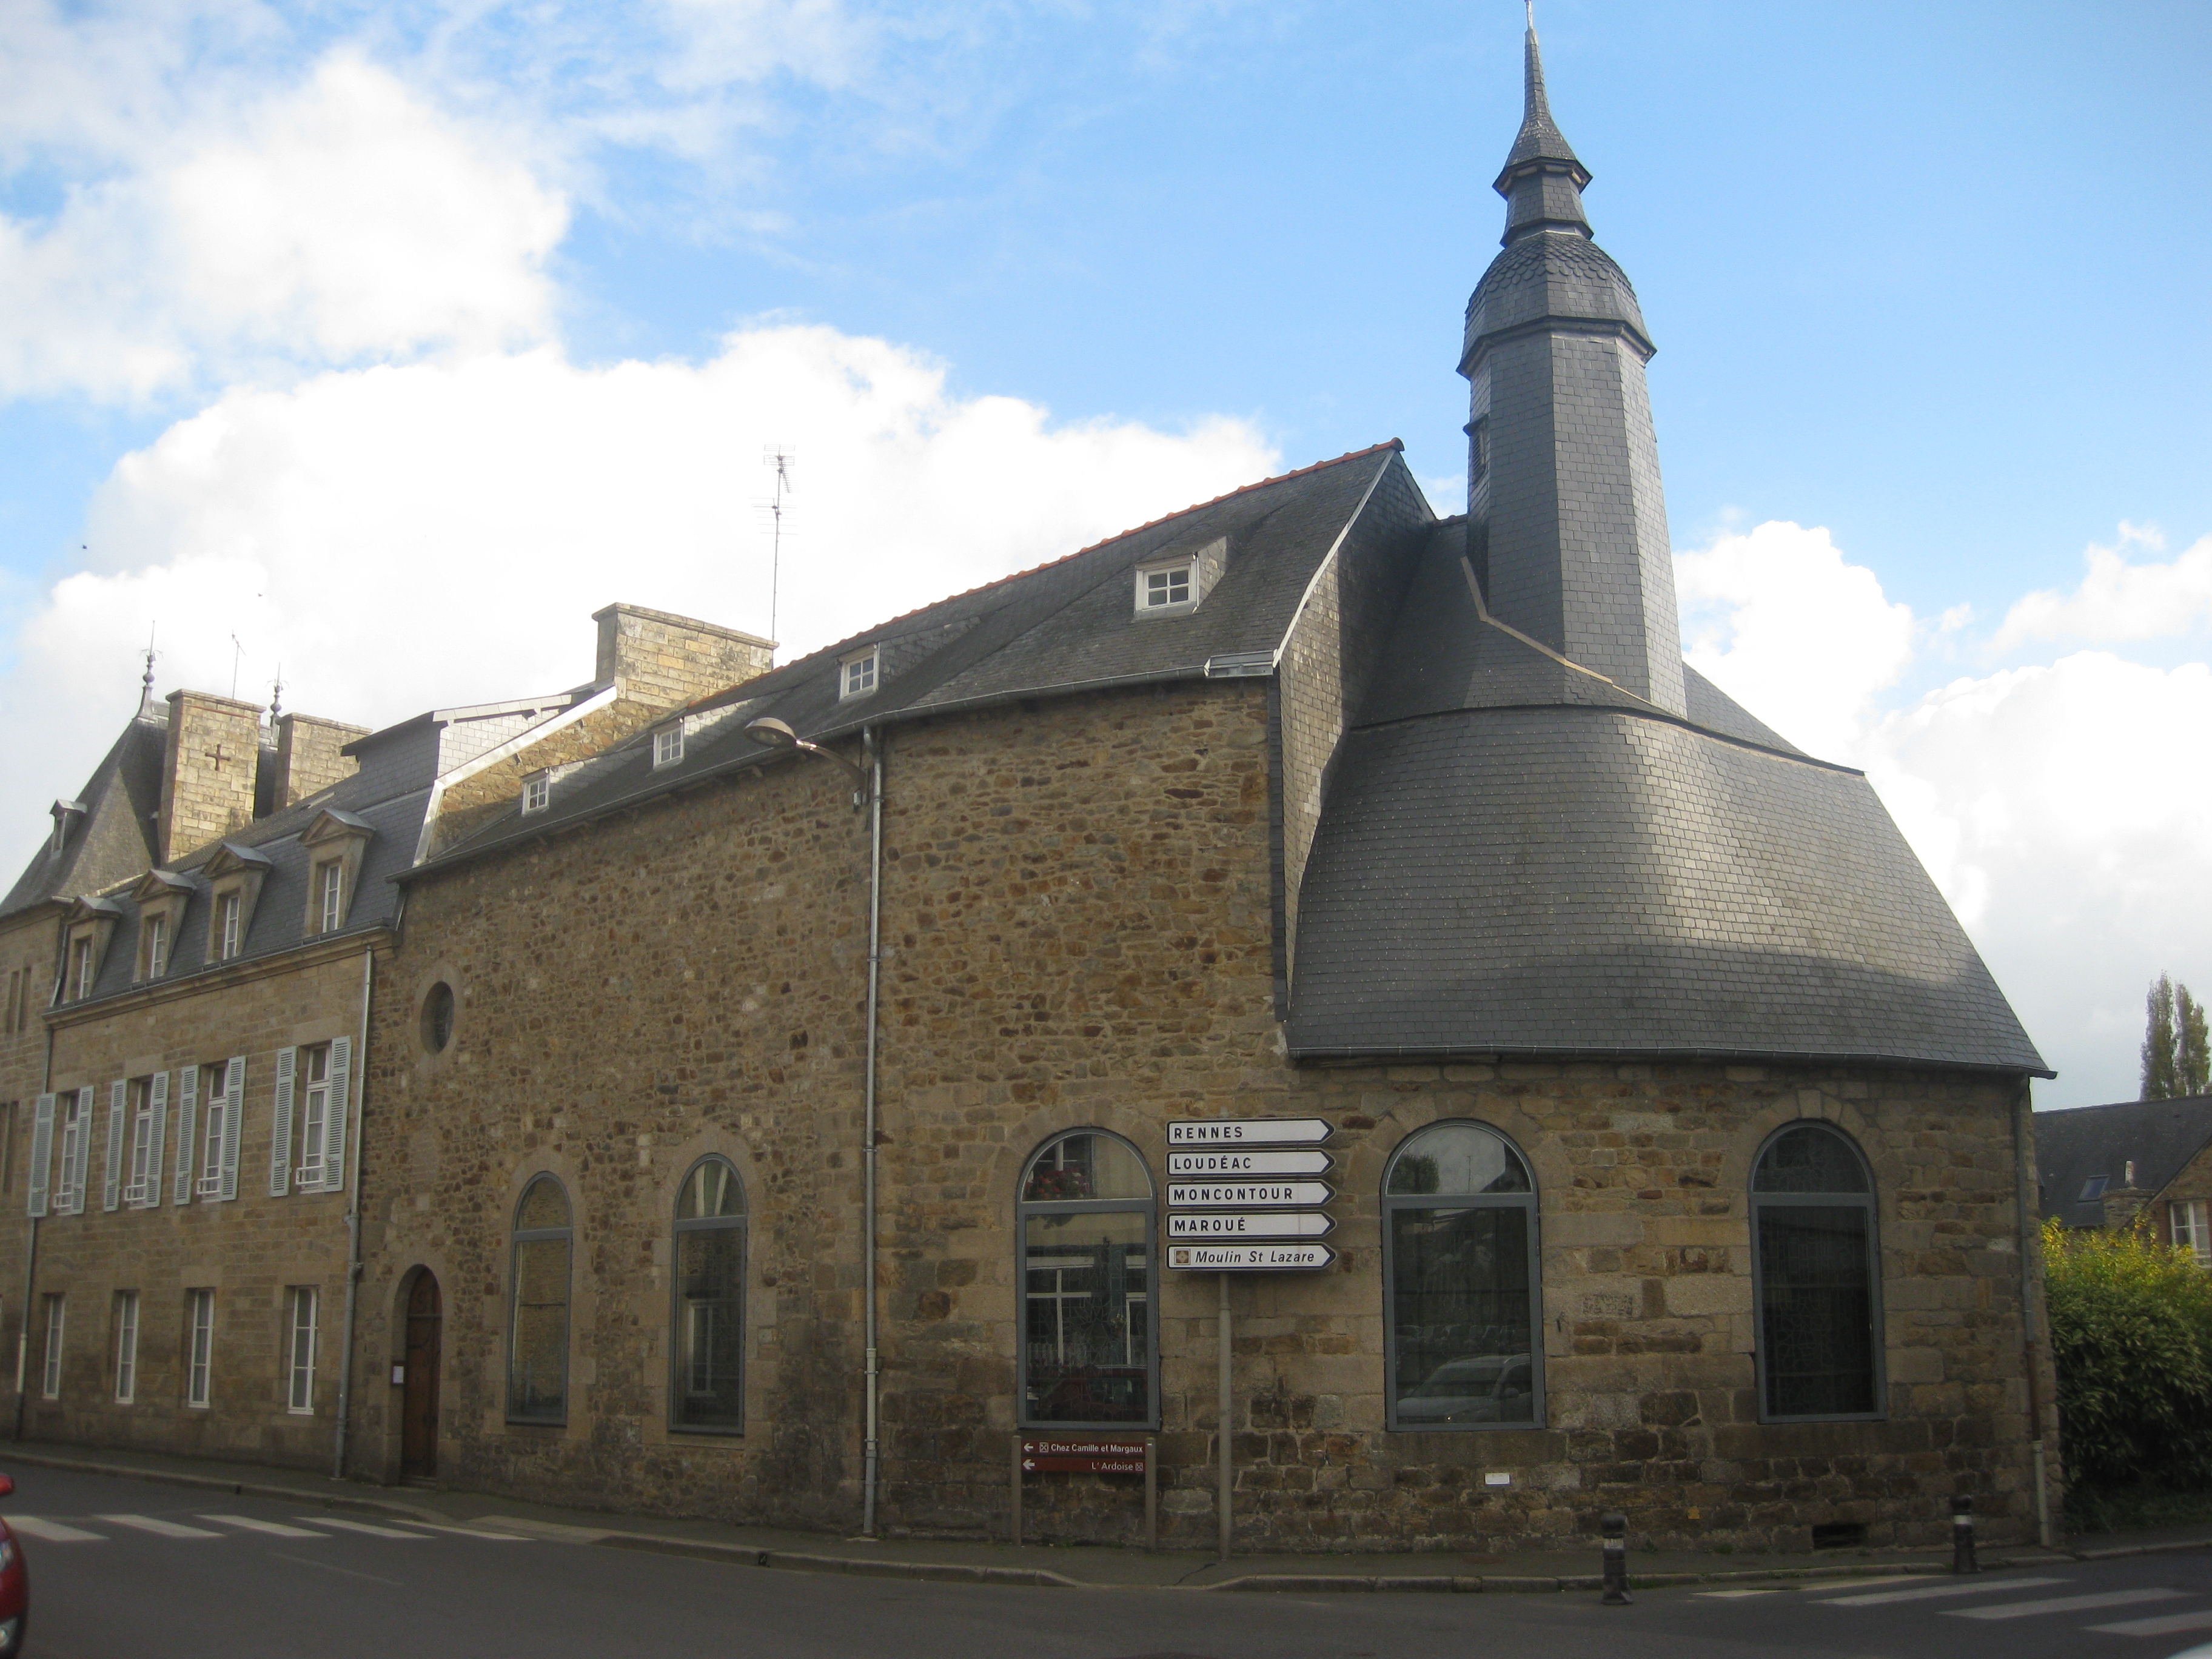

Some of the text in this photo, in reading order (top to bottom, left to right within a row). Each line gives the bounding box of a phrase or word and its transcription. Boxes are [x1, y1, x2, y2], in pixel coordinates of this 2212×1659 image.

[1174, 1127, 1242, 1139] RENNES
[1174, 1155, 1252, 1170] LOUDÉAC
[1174, 1188, 1292, 1201] MONCONTOUR
[1174, 1217, 1245, 1232] MAROUÉ
[1195, 1250, 1315, 1263] Moulin St Lazare
[1071, 1444, 1099, 1452] Camille
[1110, 1444, 1143, 1453] Margaux
